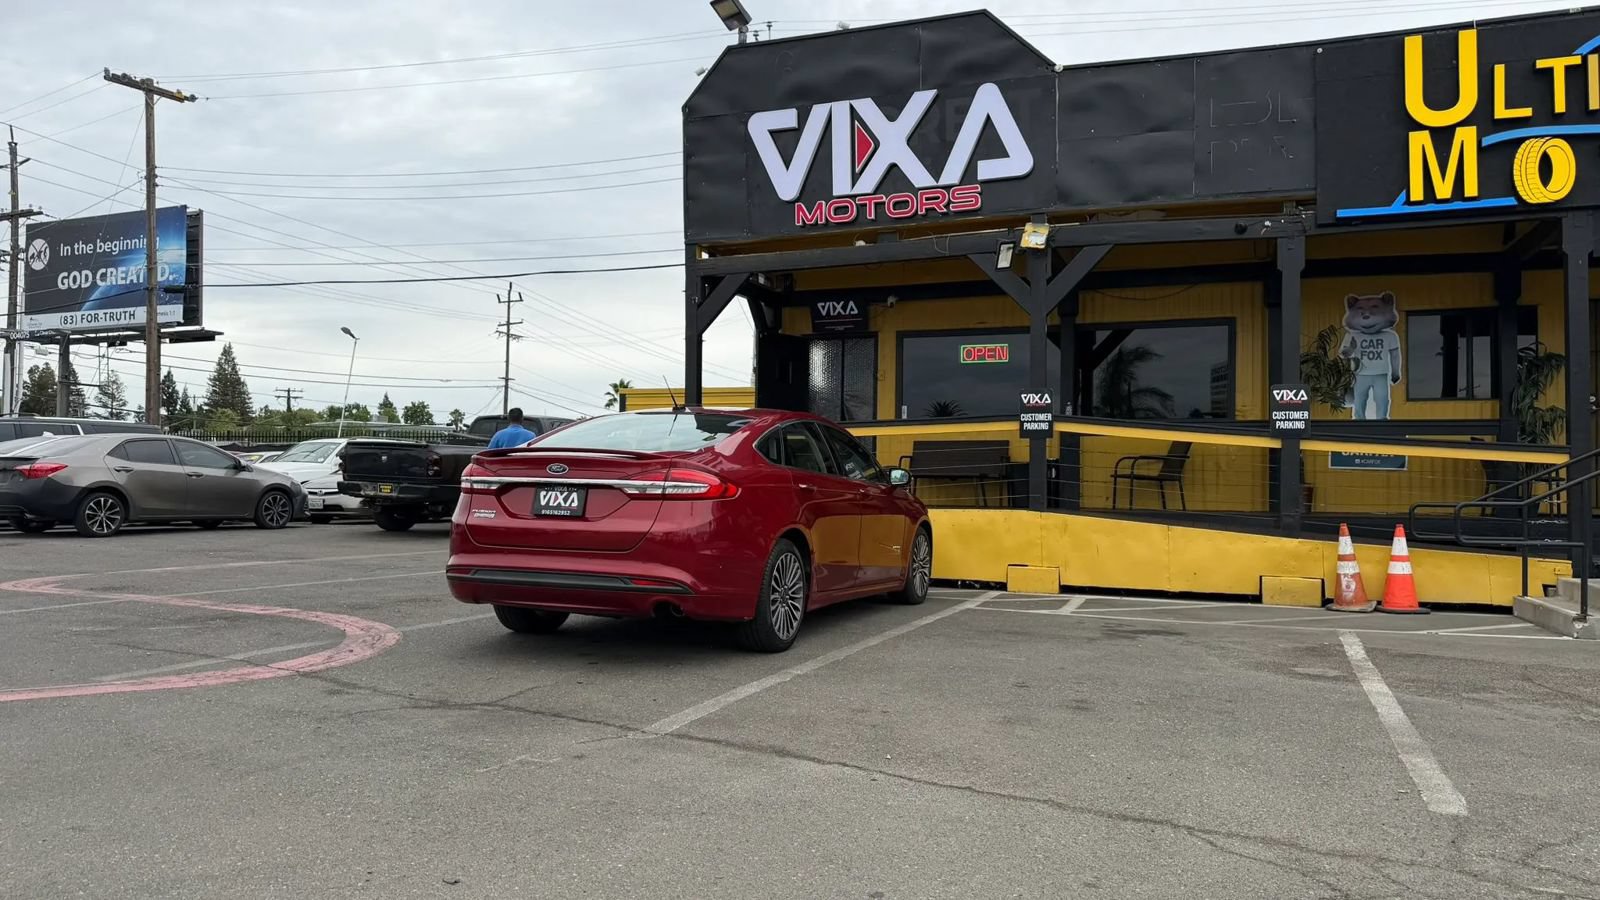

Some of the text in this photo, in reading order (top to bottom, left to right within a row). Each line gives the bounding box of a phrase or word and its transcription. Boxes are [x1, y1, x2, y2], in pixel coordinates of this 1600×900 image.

[747, 82, 1034, 201] VIXA
[794, 184, 982, 226] MOTORS
[60, 243, 71, 256] In
[74, 240, 94, 255] the
[57, 269, 93, 290] GOD
[817, 300, 858, 316] VIXA
[59, 310, 136, 326] (83) FOR-TRUTH
[1360, 338, 1384, 350] CAR
[963, 346, 1007, 361] OPEN
[1360, 350, 1383, 361] FOX
[1021, 393, 1051, 404] VIXA
[1272, 389, 1308, 401] VIXA
[1020, 413, 1052, 421] CUSTOMER
[1272, 411, 1309, 420] CUSTOMER
[1023, 422, 1049, 430] PARKING
[1275, 420, 1305, 430] PARKING
[540, 491, 578, 507] VIXA
